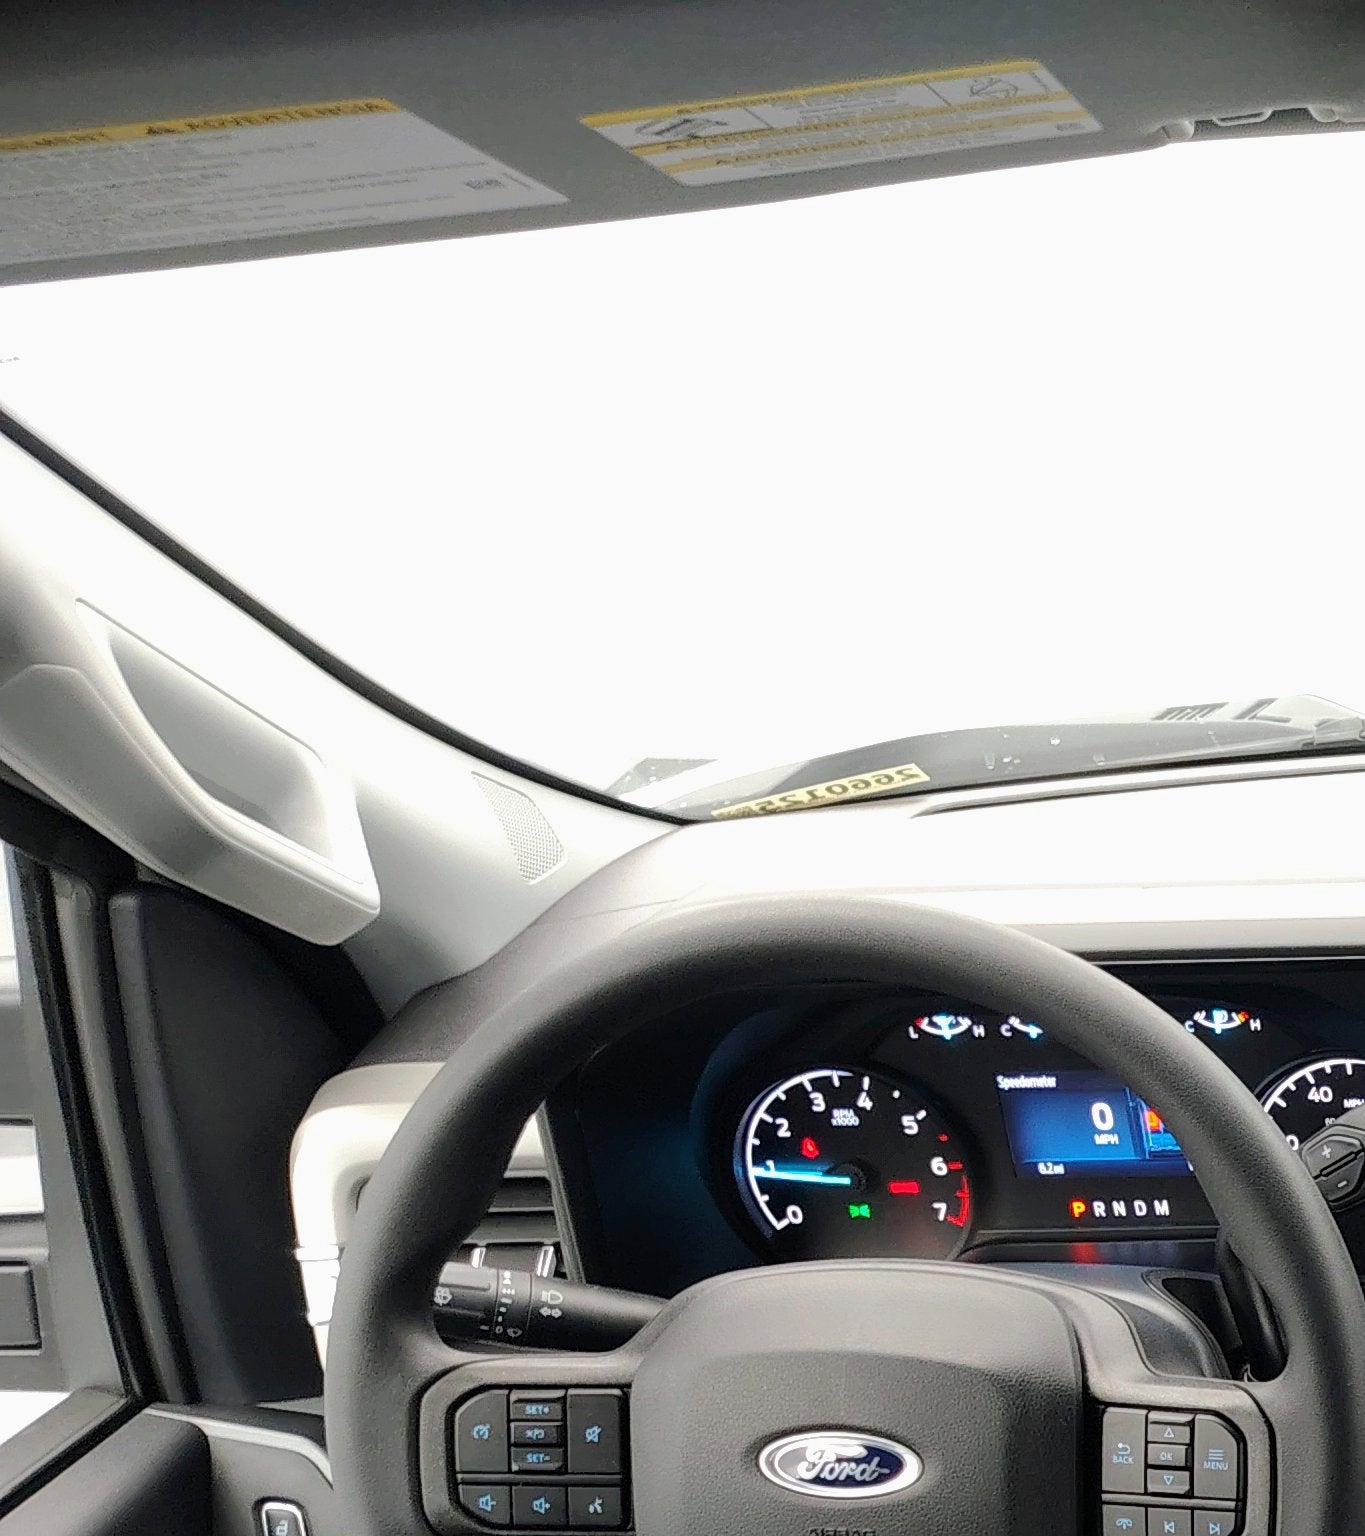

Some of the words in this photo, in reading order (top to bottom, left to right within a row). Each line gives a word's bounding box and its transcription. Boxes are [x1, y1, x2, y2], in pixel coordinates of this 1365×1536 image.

[996, 1074, 1057, 1091] Speedometer
[809, 1091, 827, 1112] 3
[856, 1091, 873, 1110] 4
[1307, 1085, 1334, 1102] 40
[832, 1108, 855, 1118] RPM
[1091, 1101, 1114, 1131] 0
[774, 1117, 792, 1138] 2
[901, 1115, 919, 1135] 5
[1093, 1134, 1119, 1145] MPH
[930, 1156, 948, 1176] 6
[786, 1205, 803, 1224] 0
[932, 1202, 948, 1222] 7
[1071, 1201, 1087, 1218] P
[1093, 1201, 1106, 1217] R
[1112, 1201, 1127, 1217] N
[1134, 1200, 1147, 1216] D
[1154, 1200, 1170, 1216] M
[795, 1443, 891, 1482] Ford
[1112, 1454, 1135, 1465] BACK
[1160, 1451, 1173, 1462] OK
[1203, 1461, 1229, 1471] MENU
